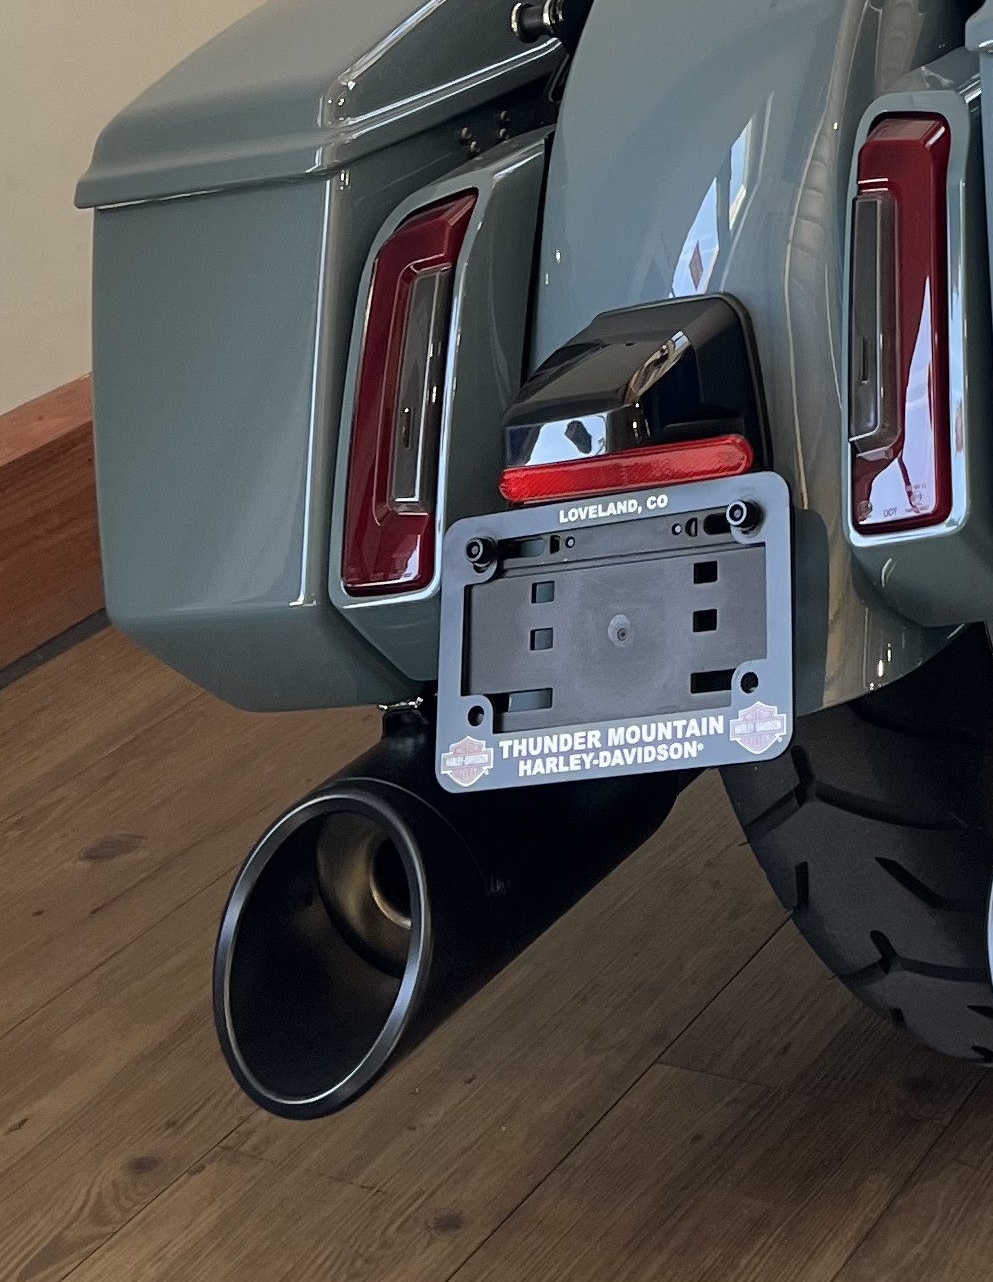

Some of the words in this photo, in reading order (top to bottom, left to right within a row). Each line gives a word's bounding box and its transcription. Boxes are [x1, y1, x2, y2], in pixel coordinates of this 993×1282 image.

[559, 499, 642, 523] LOVELAND,
[646, 494, 668, 510] CO
[499, 730, 601, 759] THUNDER
[607, 715, 724, 747] MOUNTAIN
